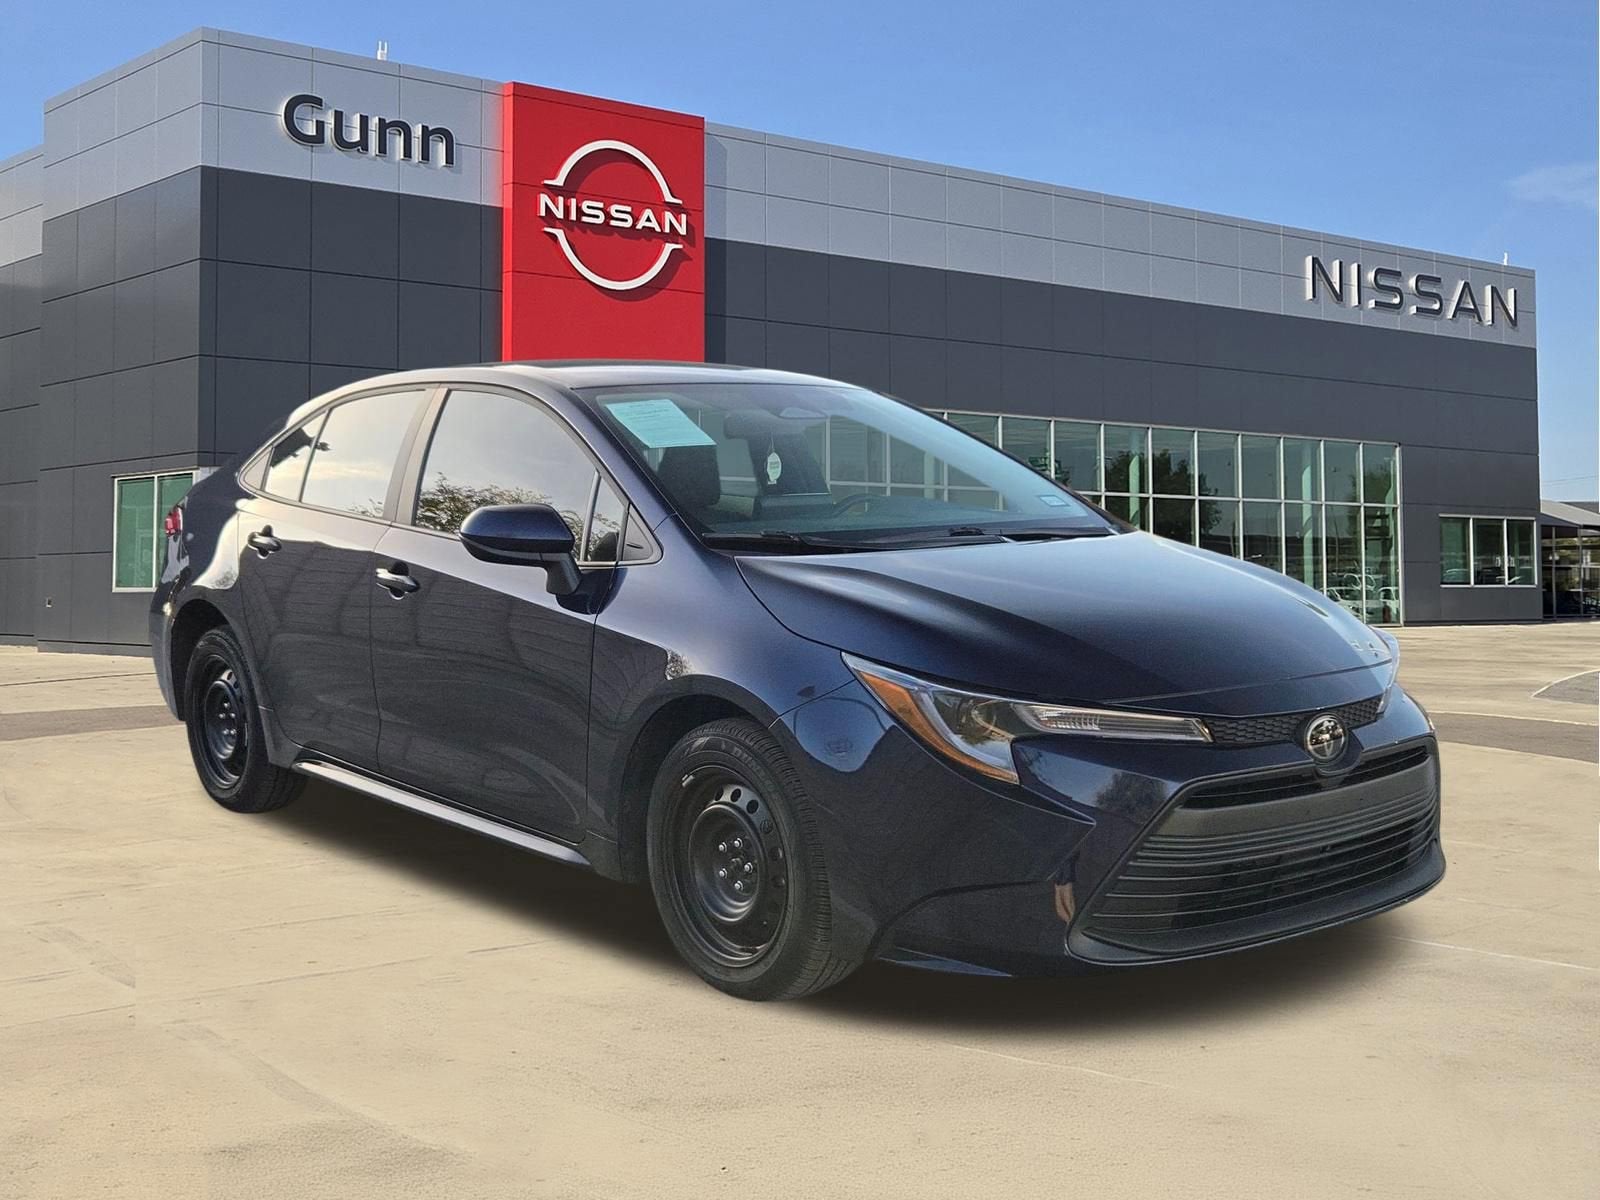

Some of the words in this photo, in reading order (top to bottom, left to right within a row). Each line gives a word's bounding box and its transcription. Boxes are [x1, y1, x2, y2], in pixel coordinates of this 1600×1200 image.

[282, 93, 455, 168] Gunn
[538, 193, 687, 236] NISSAN
[1305, 255, 1518, 328] NISSAN
